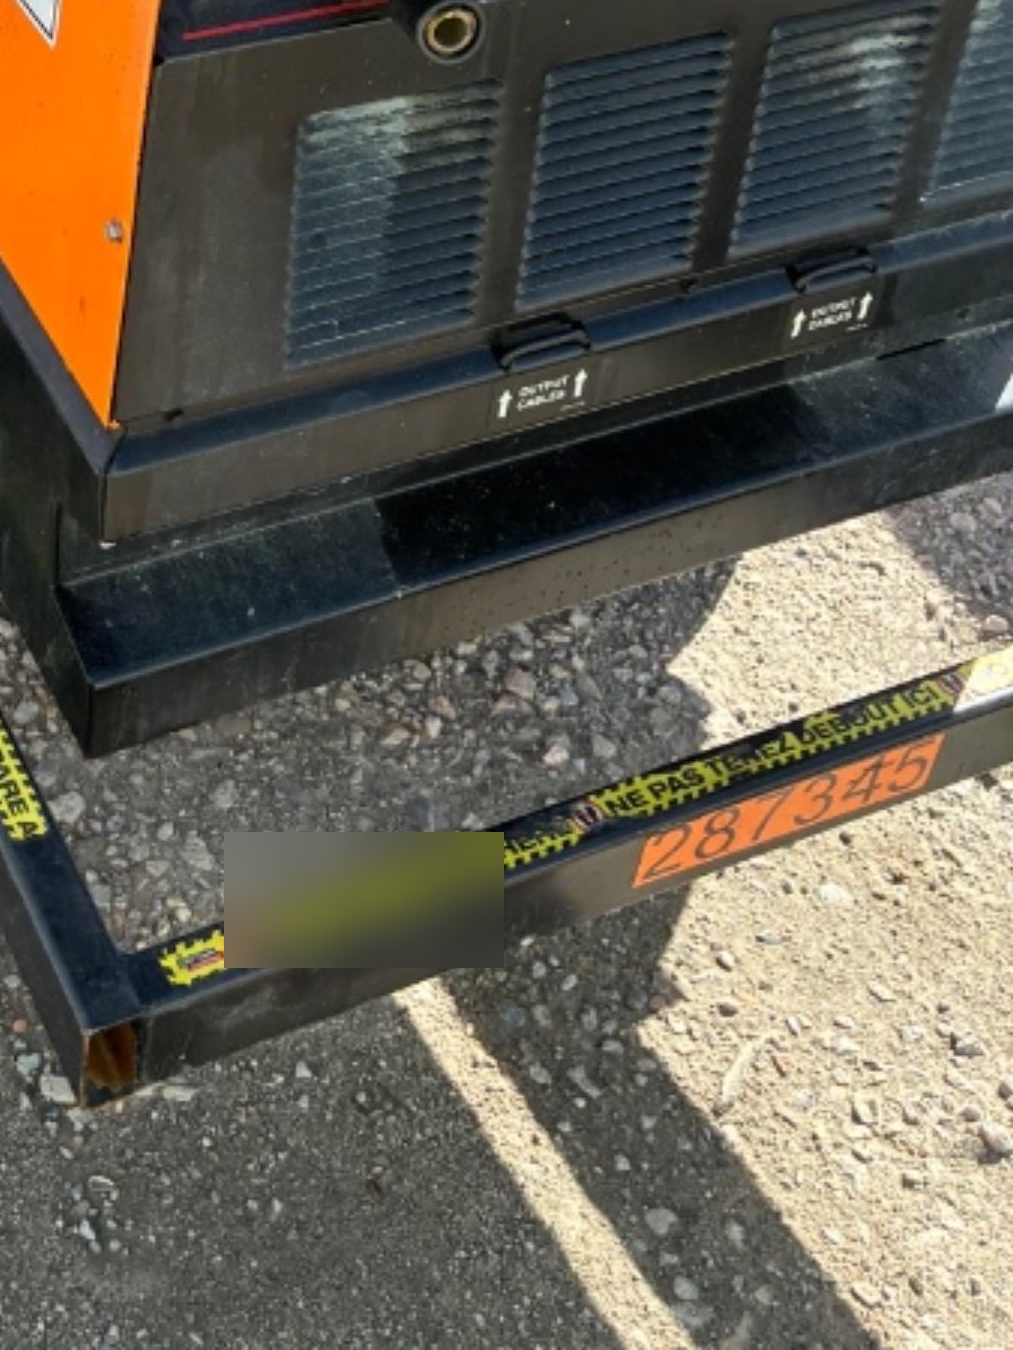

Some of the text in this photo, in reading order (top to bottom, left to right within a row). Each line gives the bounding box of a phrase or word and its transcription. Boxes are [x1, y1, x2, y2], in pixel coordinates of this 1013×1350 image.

[605, 789, 647, 812] NE
[647, 767, 705, 798] PAS
[644, 748, 929, 880] 287345
